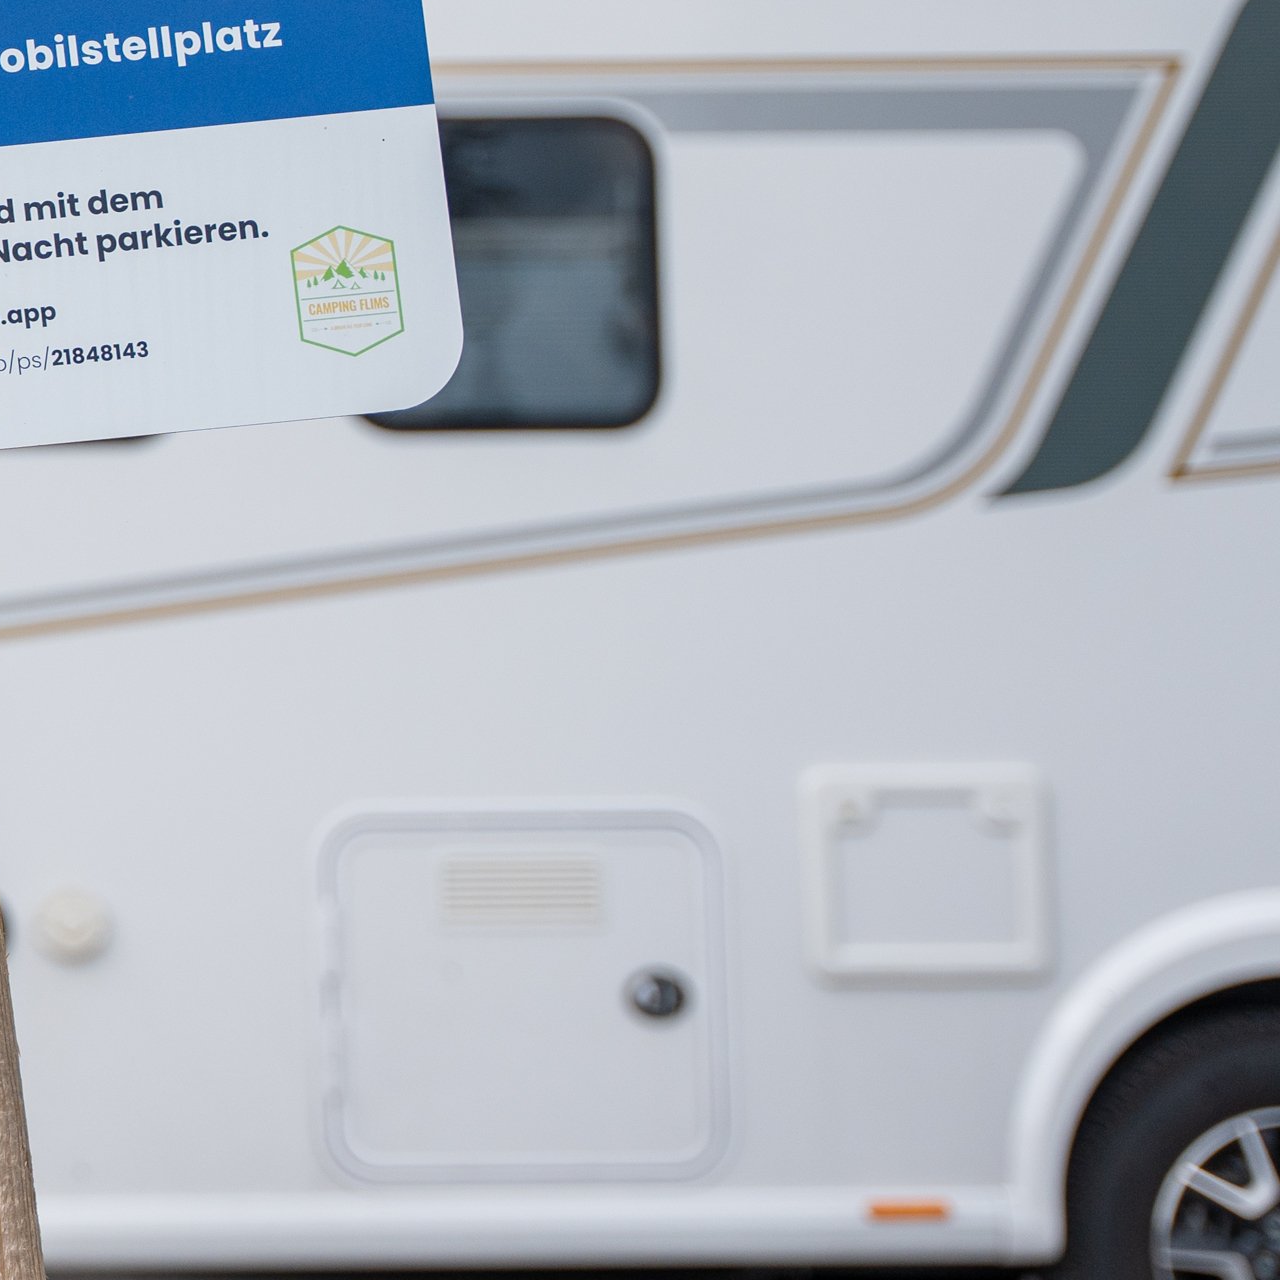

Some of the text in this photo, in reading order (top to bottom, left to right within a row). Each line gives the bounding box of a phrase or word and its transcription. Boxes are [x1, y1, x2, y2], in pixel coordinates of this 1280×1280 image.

[24, 192, 80, 221] mit
[88, 189, 163, 214] dem
[96, 220, 268, 262] parkieren.
[309, 297, 389, 316] CAMPING FLIMS
